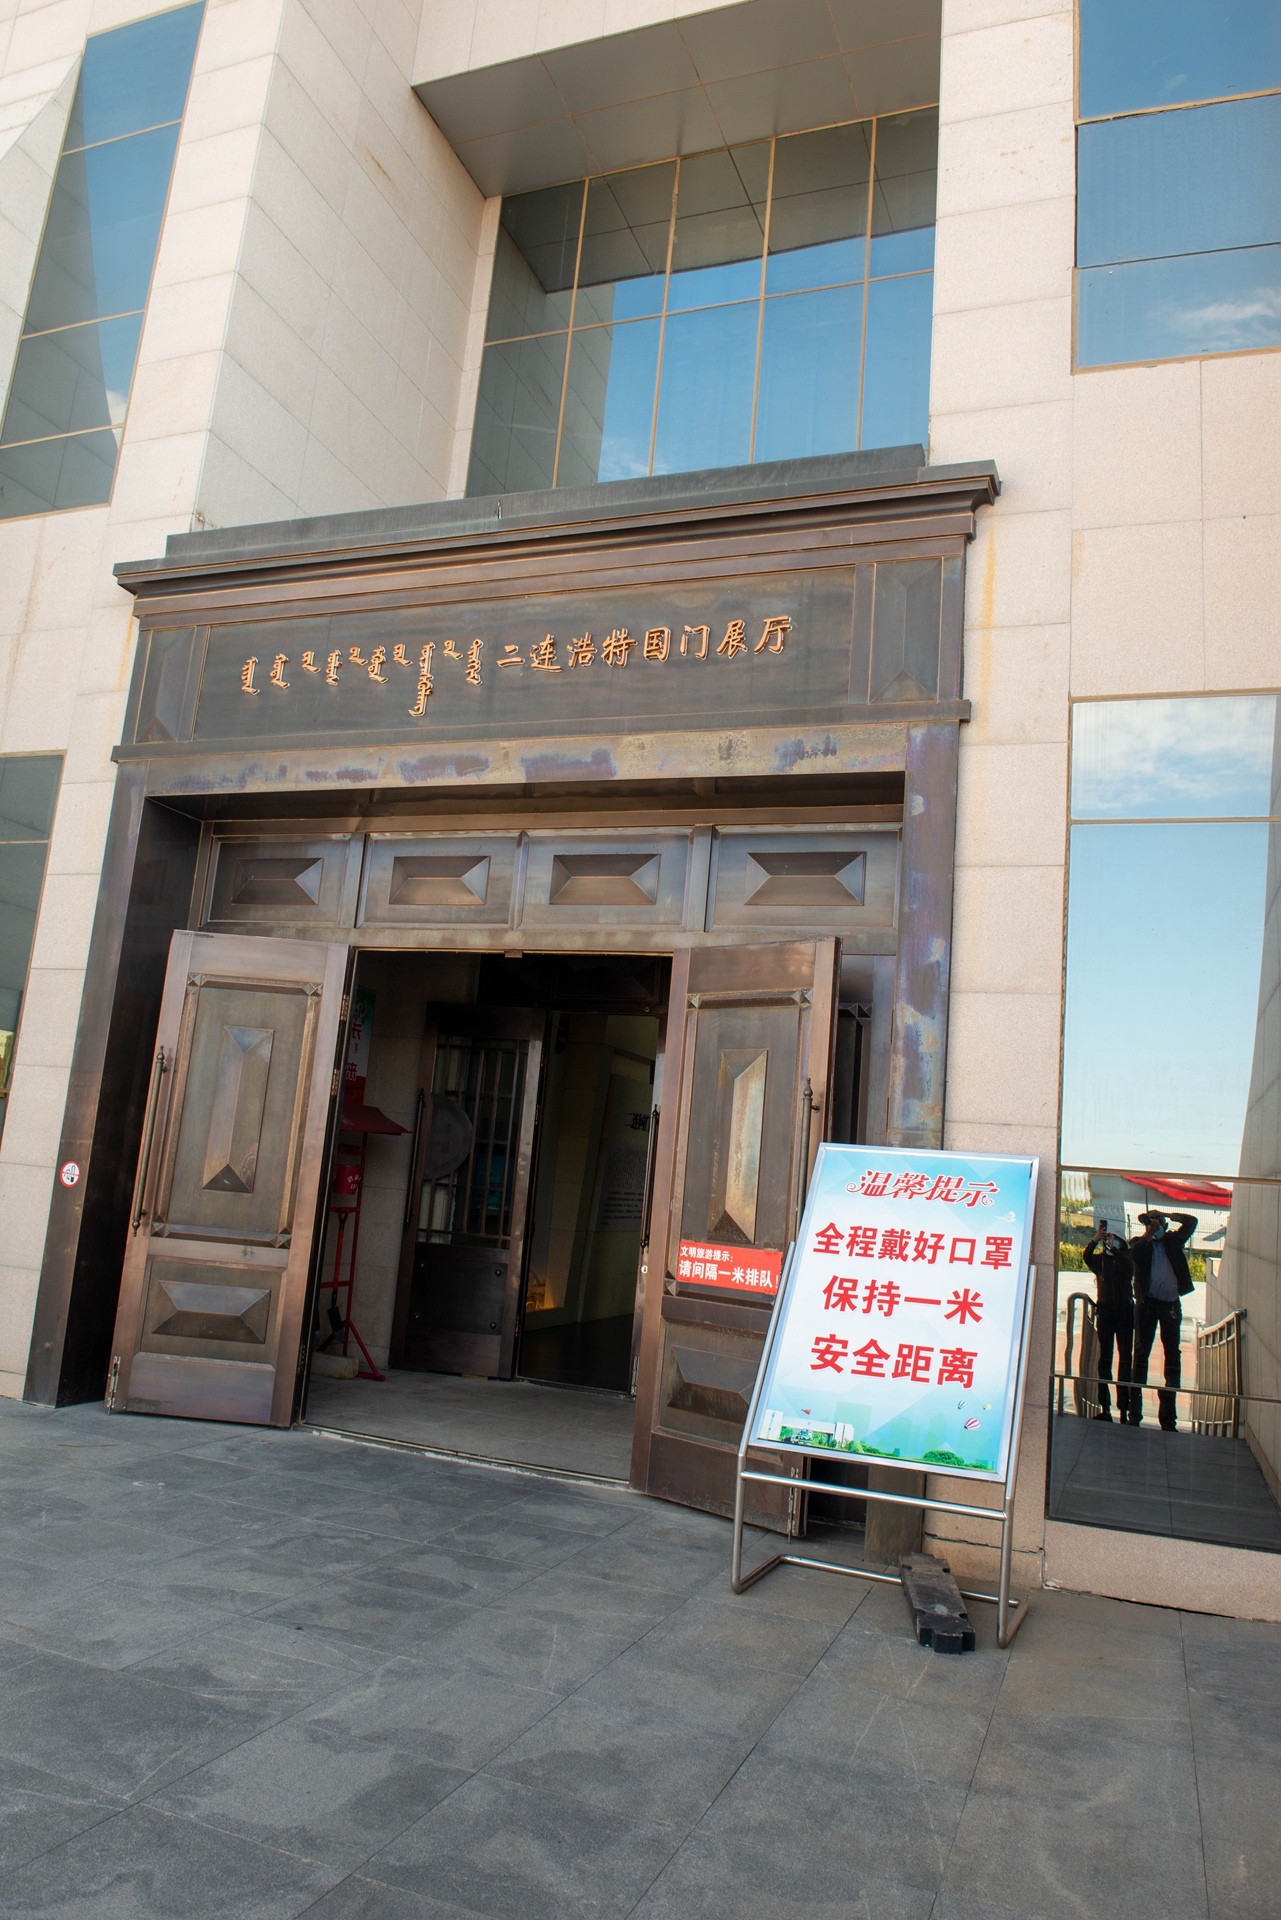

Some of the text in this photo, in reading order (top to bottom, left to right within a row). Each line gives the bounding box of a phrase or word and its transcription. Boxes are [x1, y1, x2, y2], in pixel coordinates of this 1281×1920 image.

[496, 615, 792, 673] 二连浩特国门展厅
[846, 1170, 999, 1207] 温馨提示
[680, 1245, 734, 1263] 文明旅游提示：
[813, 1222, 1013, 1270] 全程戴好口罩
[679, 1259, 780, 1289] 请间隔一米排队！
[823, 1275, 984, 1325] 保持一米
[810, 1333, 978, 1389] 安全距离
